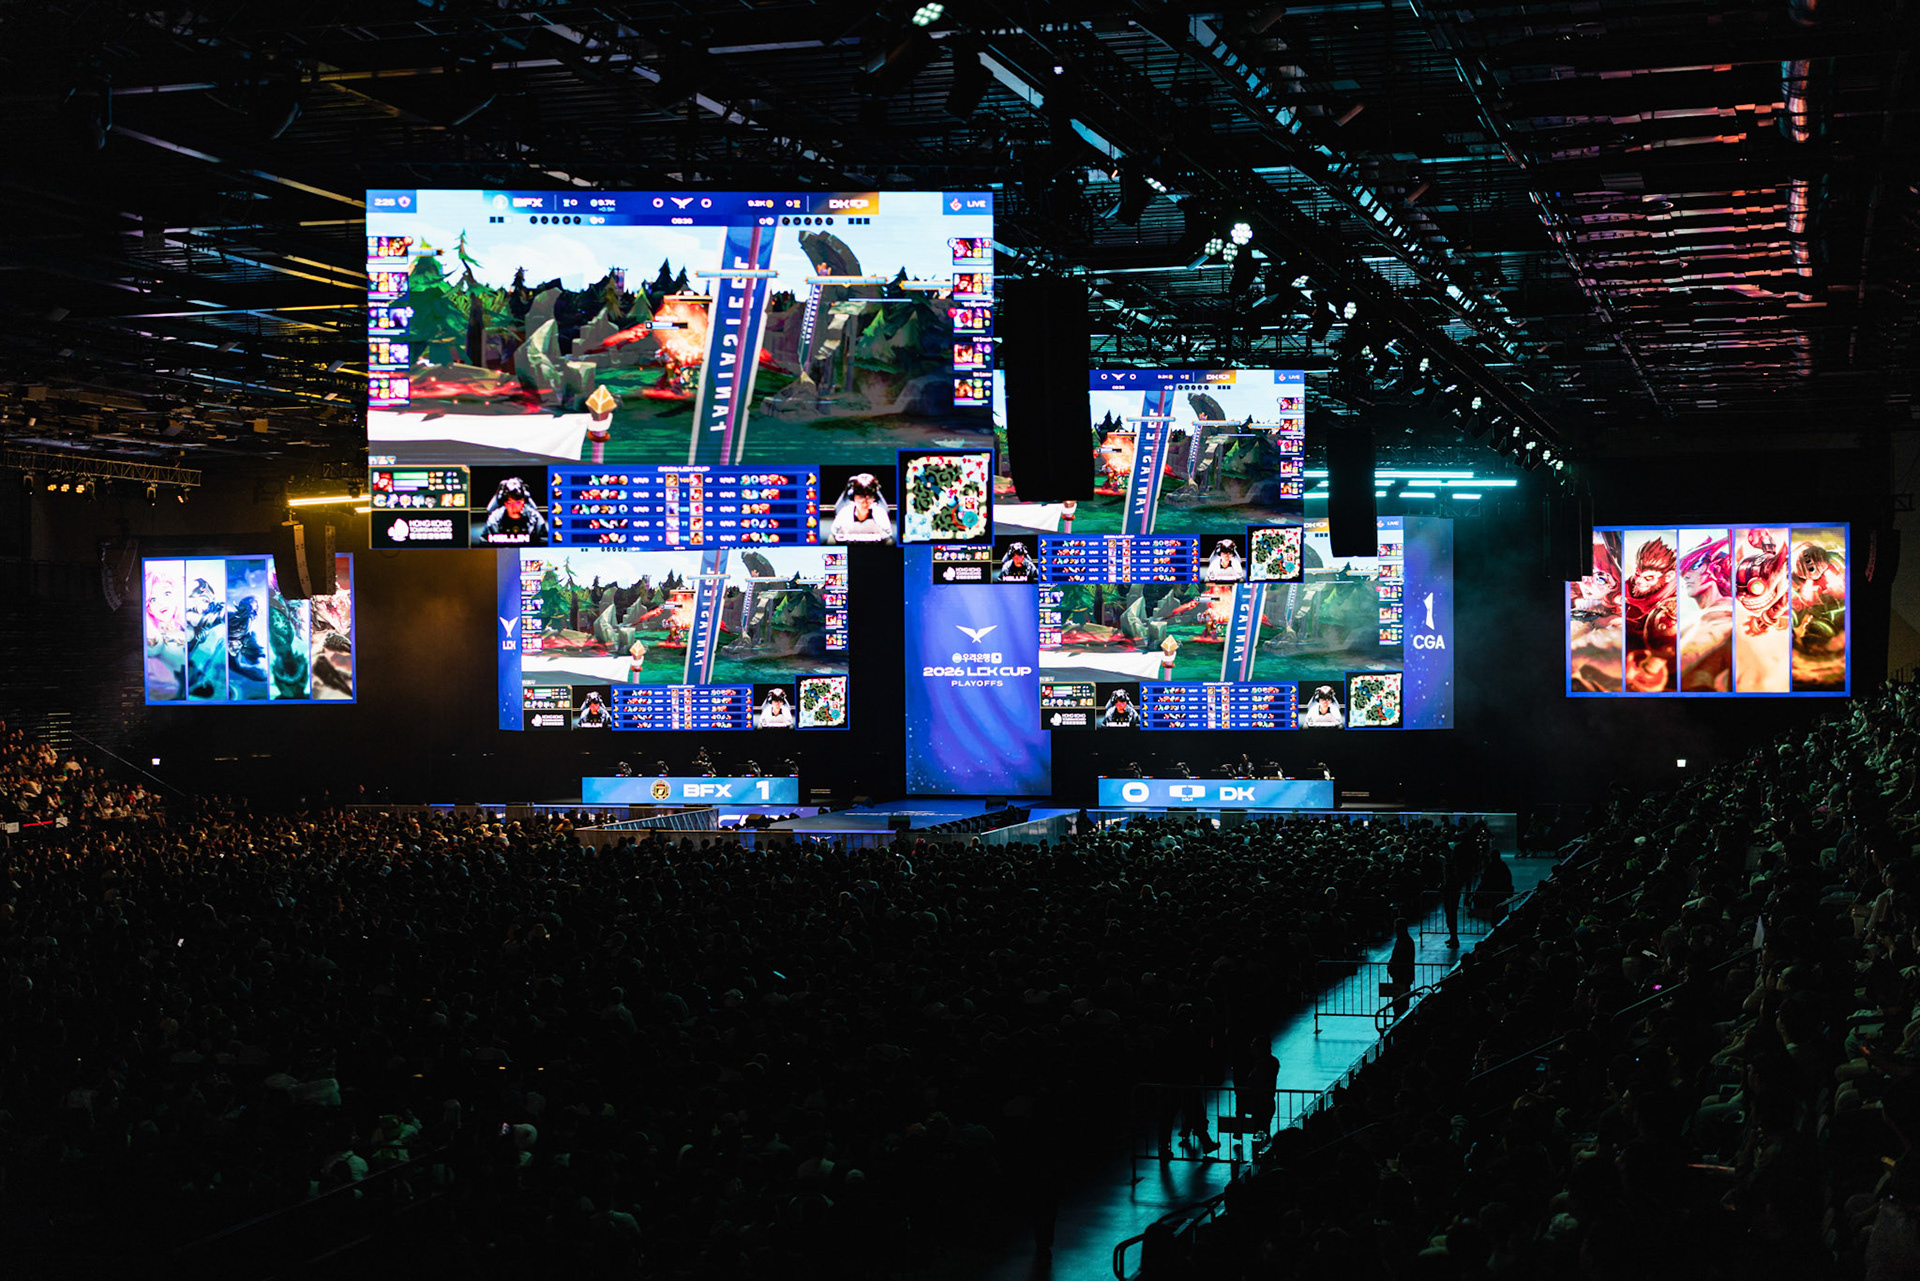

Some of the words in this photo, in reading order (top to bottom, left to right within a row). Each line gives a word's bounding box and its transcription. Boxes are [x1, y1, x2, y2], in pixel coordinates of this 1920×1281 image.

[512, 198, 543, 208] BFX
[652, 198, 664, 208] 0
[700, 198, 712, 208] 0
[828, 199, 850, 209] DK
[966, 200, 986, 208] LIVE
[488, 534, 530, 543] KELLIN
[502, 641, 516, 650] LCK
[1413, 634, 1445, 650] CGA
[962, 653, 990, 663] 우리은행
[922, 666, 965, 677] 2026
[967, 666, 997, 677] LCK
[1000, 666, 1032, 677] CUP
[683, 783, 732, 798] BFX
[756, 781, 769, 800] 1
[1121, 782, 1150, 803] 0
[1220, 786, 1256, 801] DK
